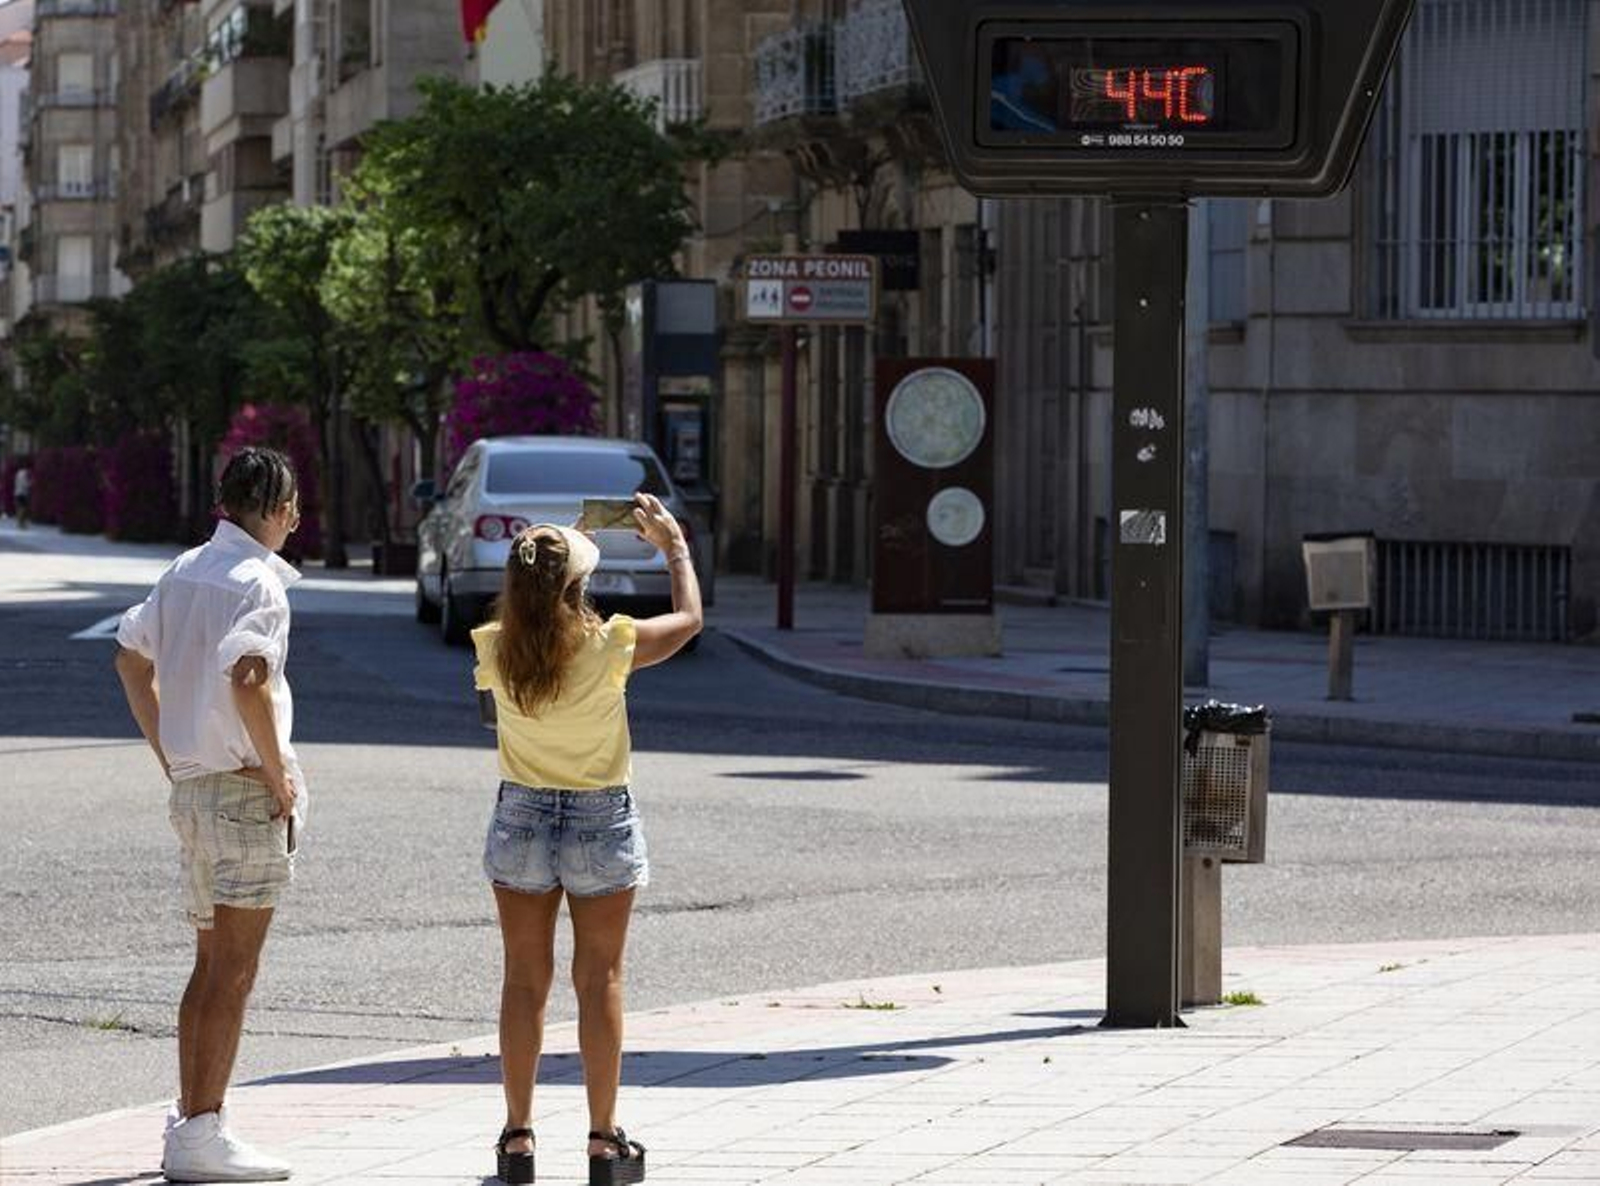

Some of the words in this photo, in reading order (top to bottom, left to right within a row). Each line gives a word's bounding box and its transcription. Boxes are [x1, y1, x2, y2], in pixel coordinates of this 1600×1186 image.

[1133, 134, 1149, 146] 54
[1150, 134, 1167, 146] 50
[1167, 134, 1185, 146] 50
[748, 259, 798, 277] ZONA
[803, 260, 871, 278] PEONIL
